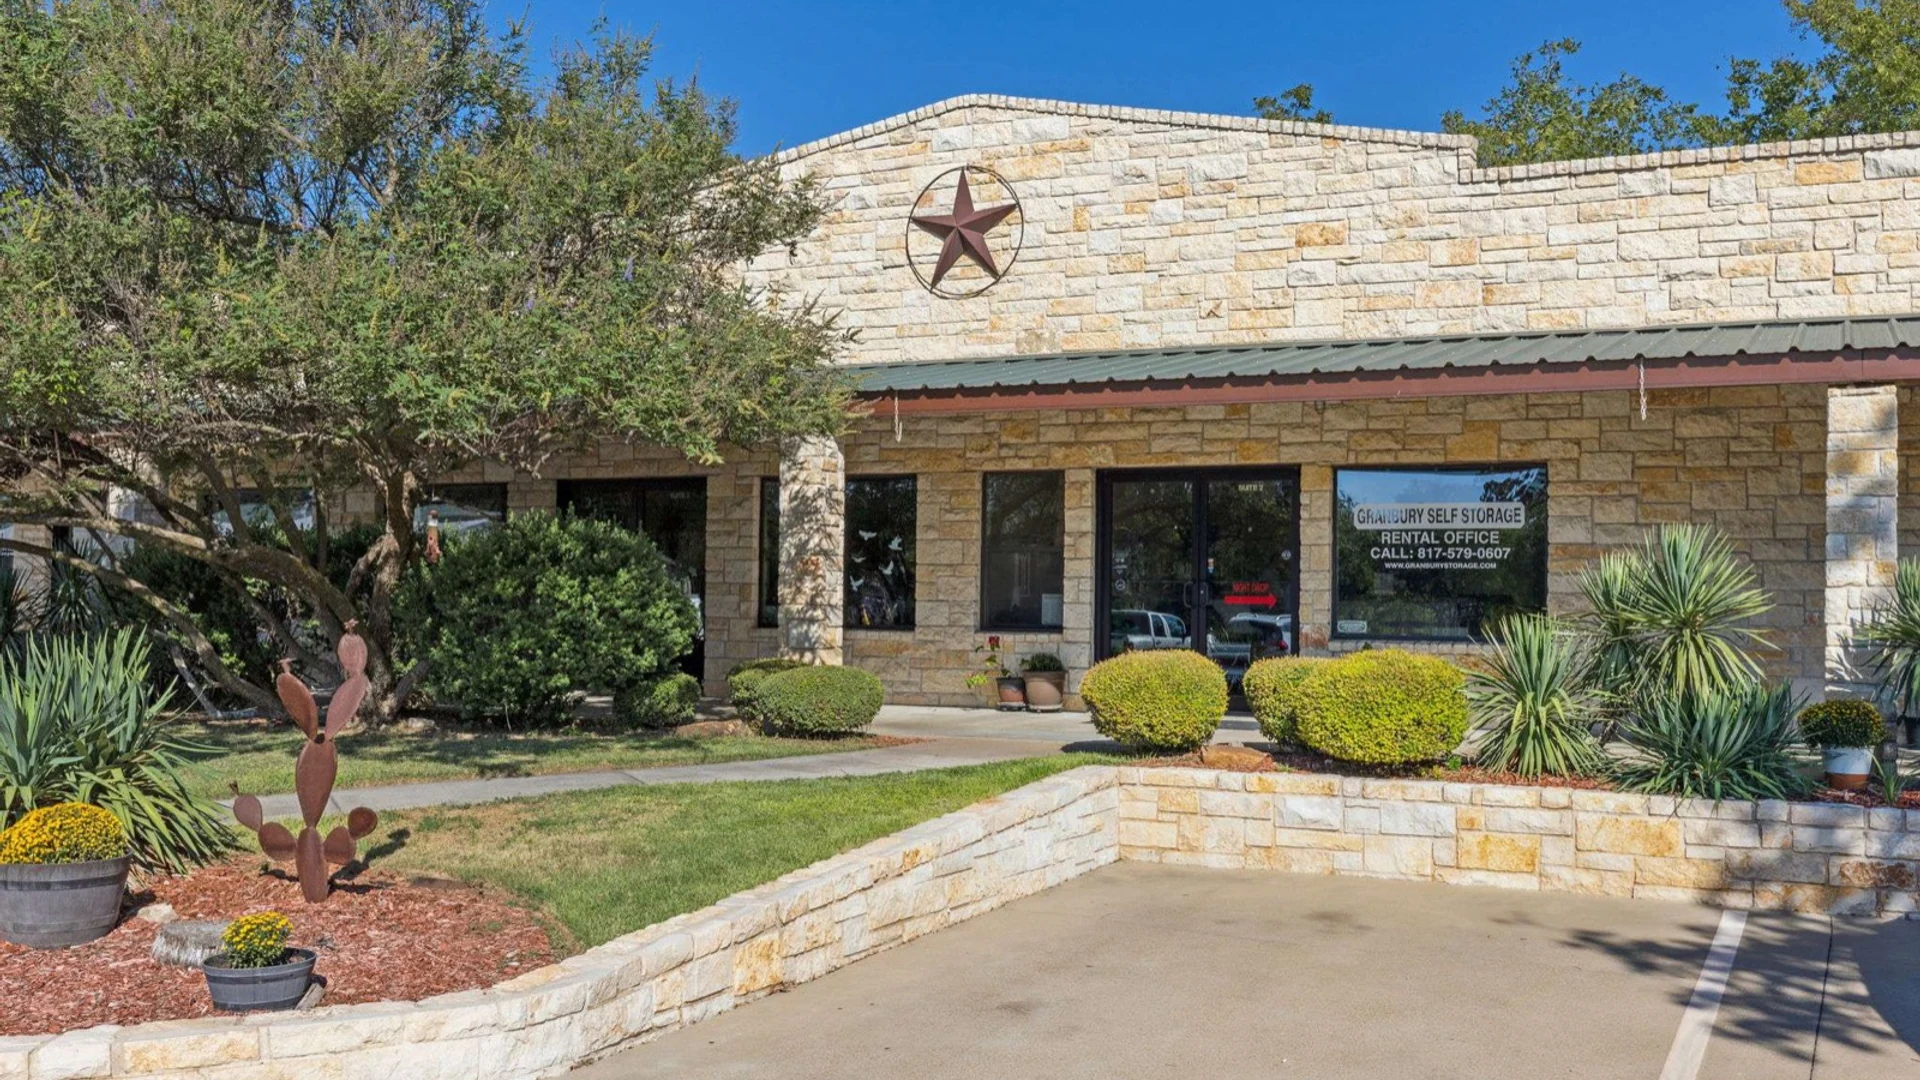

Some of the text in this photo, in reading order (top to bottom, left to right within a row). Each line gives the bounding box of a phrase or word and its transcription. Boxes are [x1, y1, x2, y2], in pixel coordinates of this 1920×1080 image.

[1357, 507, 1522, 524] GRANBURY SELF STORAGE
[1381, 531, 1499, 544] RENTAL OFFICE
[1370, 548, 1511, 559] CALL: 817-579-0607
